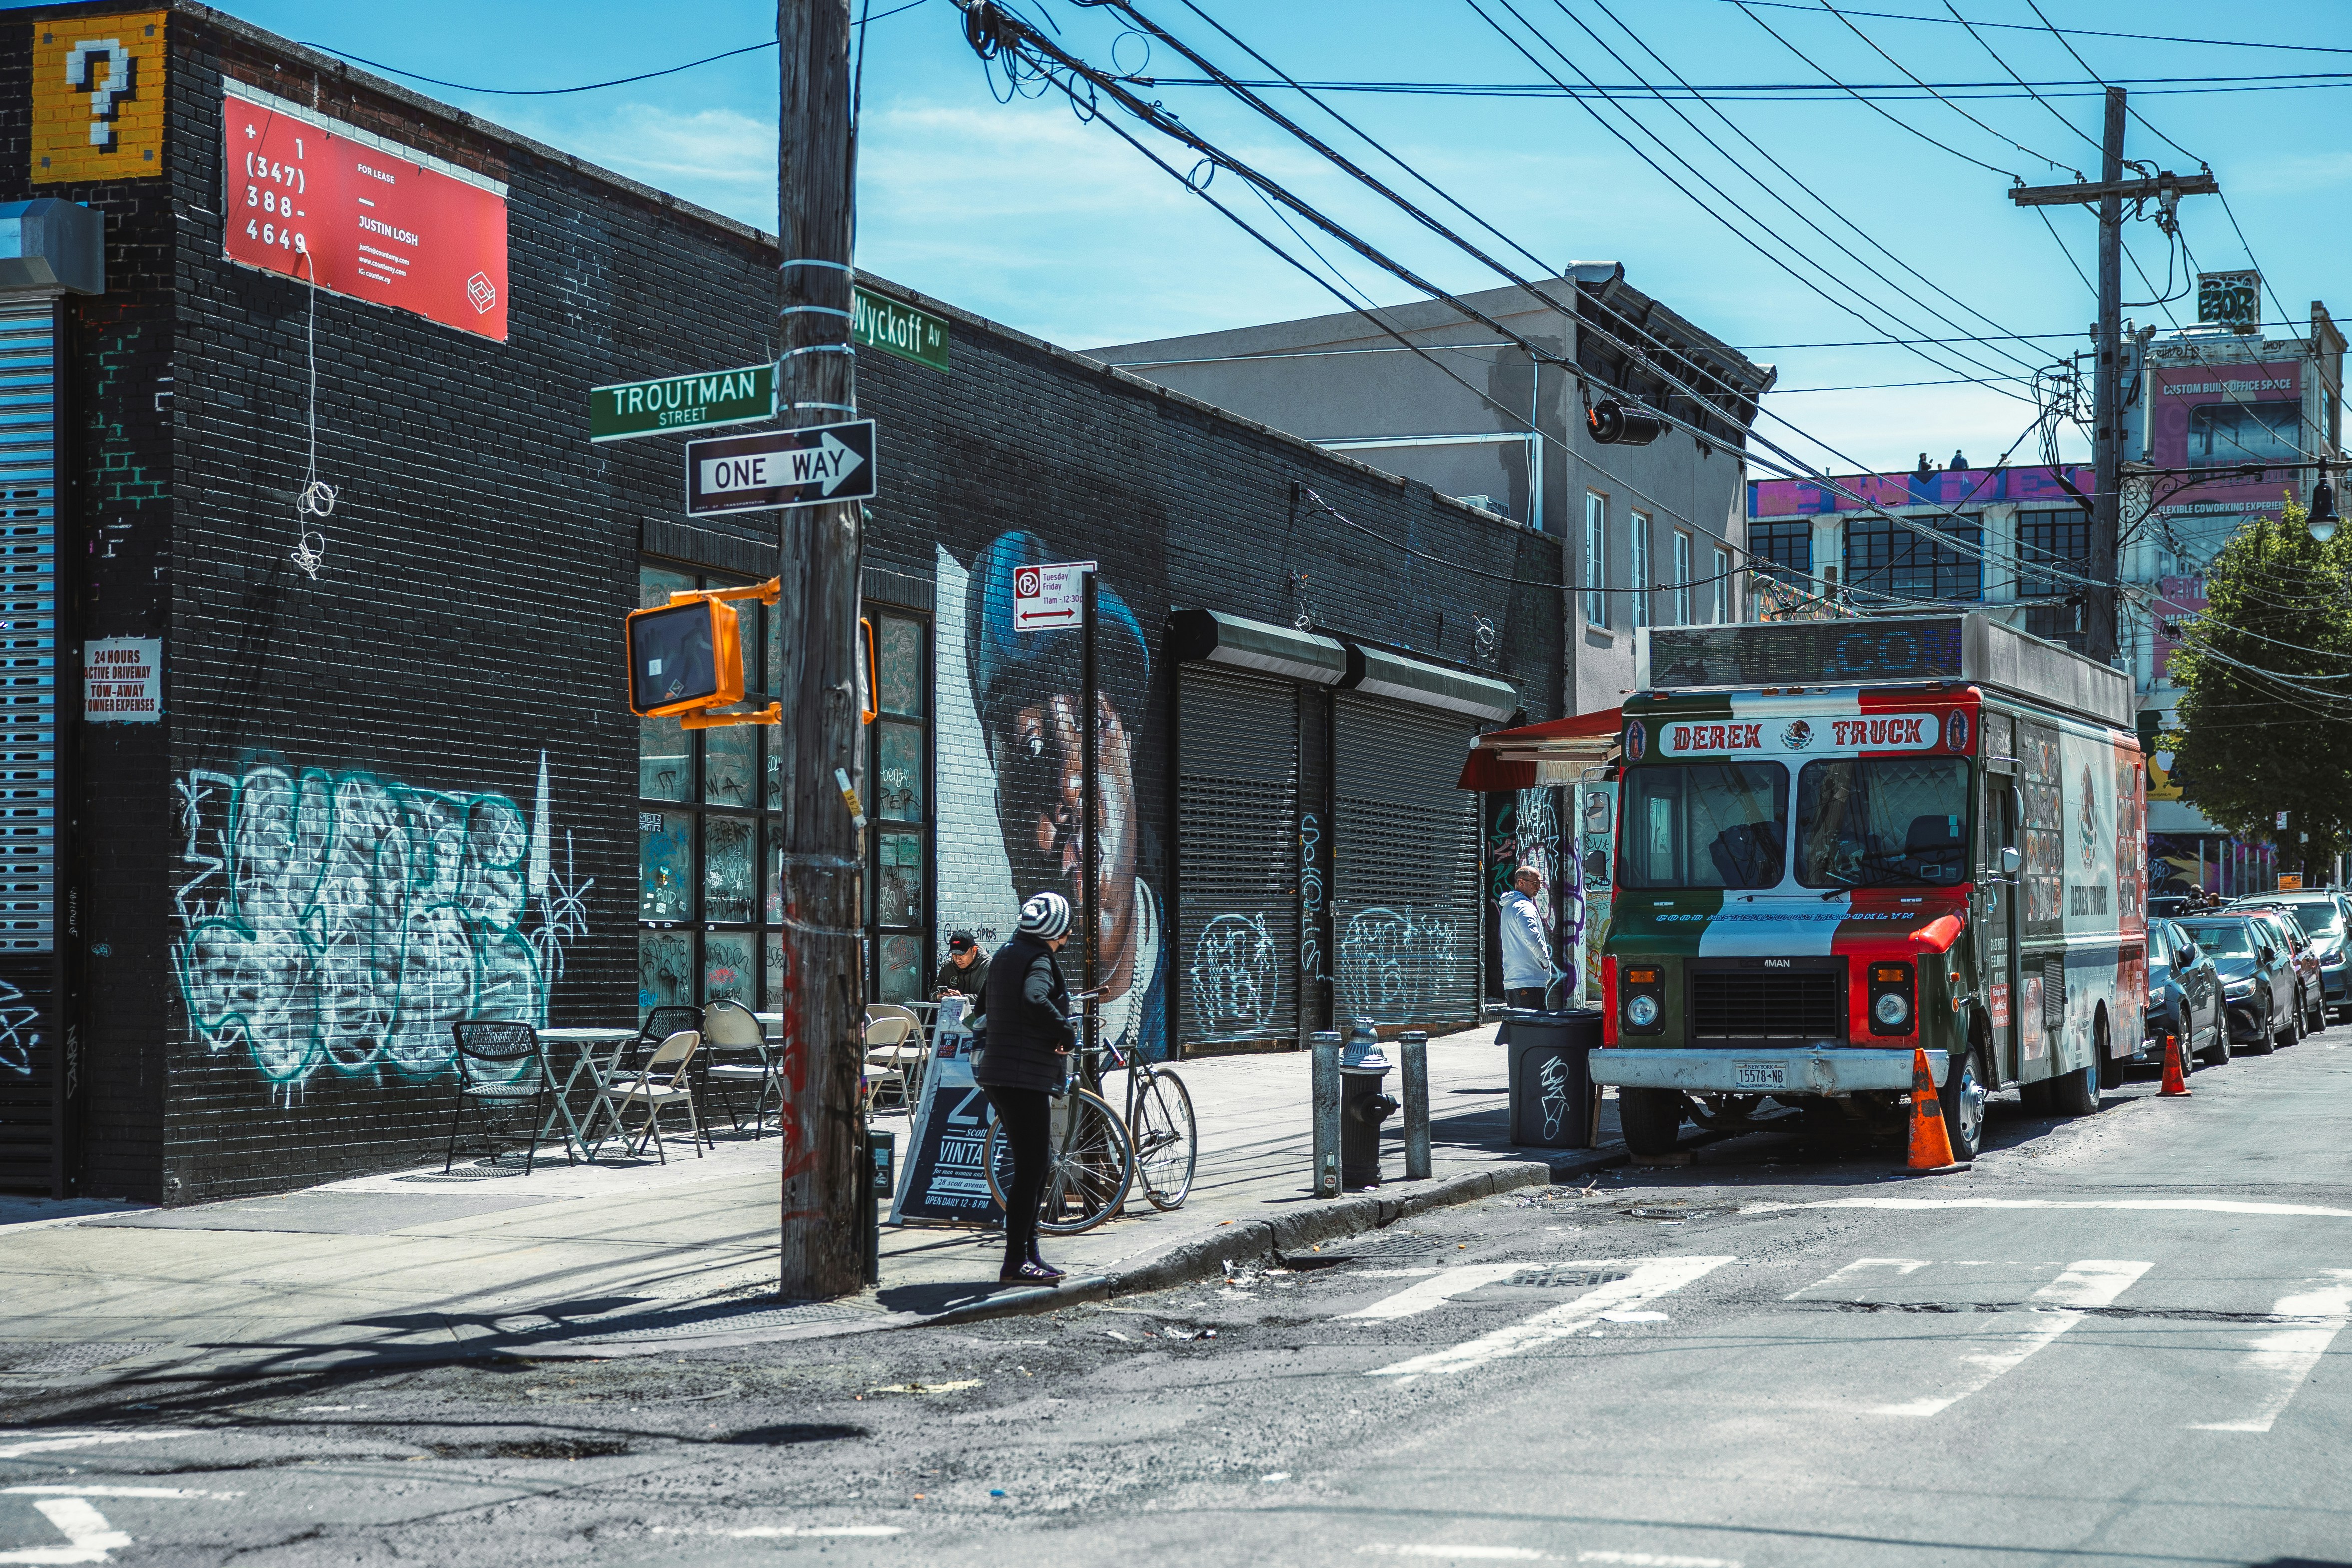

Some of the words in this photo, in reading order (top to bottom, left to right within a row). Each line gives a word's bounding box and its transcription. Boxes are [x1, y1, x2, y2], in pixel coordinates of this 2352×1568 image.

[295, 138, 303, 159] 1
[247, 151, 305, 194] (347)
[358, 163, 373, 176] FOR
[373, 170, 395, 184] LEASE
[247, 185, 305, 218] 388-
[246, 219, 306, 253] 4649
[358, 215, 392, 237] JUSTIN
[393, 227, 419, 246] LOSH
[928, 324, 940, 347] Av
[612, 371, 756, 415] TROUTMAN
[2163, 382, 2201, 395] CUSTOM
[2230, 380, 2260, 392] OFFICE
[2261, 378, 2292, 390] SPACE
[659, 407, 708, 426] STREET
[715, 458, 766, 489] ONE
[792, 449, 846, 481] WAY
[2158, 504, 2193, 515] FLEXIBLE
[2194, 502, 2245, 513] COWORKING
[1043, 572, 1069, 581] Tuesday
[1043, 583, 1062, 591] Friday
[2163, 577, 2204, 600] RENT
[94, 650, 106, 664] 24
[107, 650, 140, 664] HOURS
[84, 666, 110, 680] ACTIVE
[112, 666, 151, 679] DRIVEWAY
[91, 684, 145, 698] TOW-AWAY
[88, 698, 114, 712] OWNER
[116, 698, 155, 712] EXPENSES
[1673, 723, 1764, 751] DEREK
[1832, 718, 1925, 746] TRUCK
[2071, 886, 2090, 916] DEREK
[2090, 885, 2107, 916] TRUCK
[1706, 913, 1813, 922] AFTERNOON
[1813, 913, 1914, 922] BROOKLYN
[966, 1128, 988, 1137] scott
[940, 1141, 1006, 1166] VINTAE
[925, 1196, 941, 1205] OPEN
[942, 1197, 960, 1207] DAILY
[960, 1199, 968, 1207] 12
[978, 1200, 989, 1209] PM
